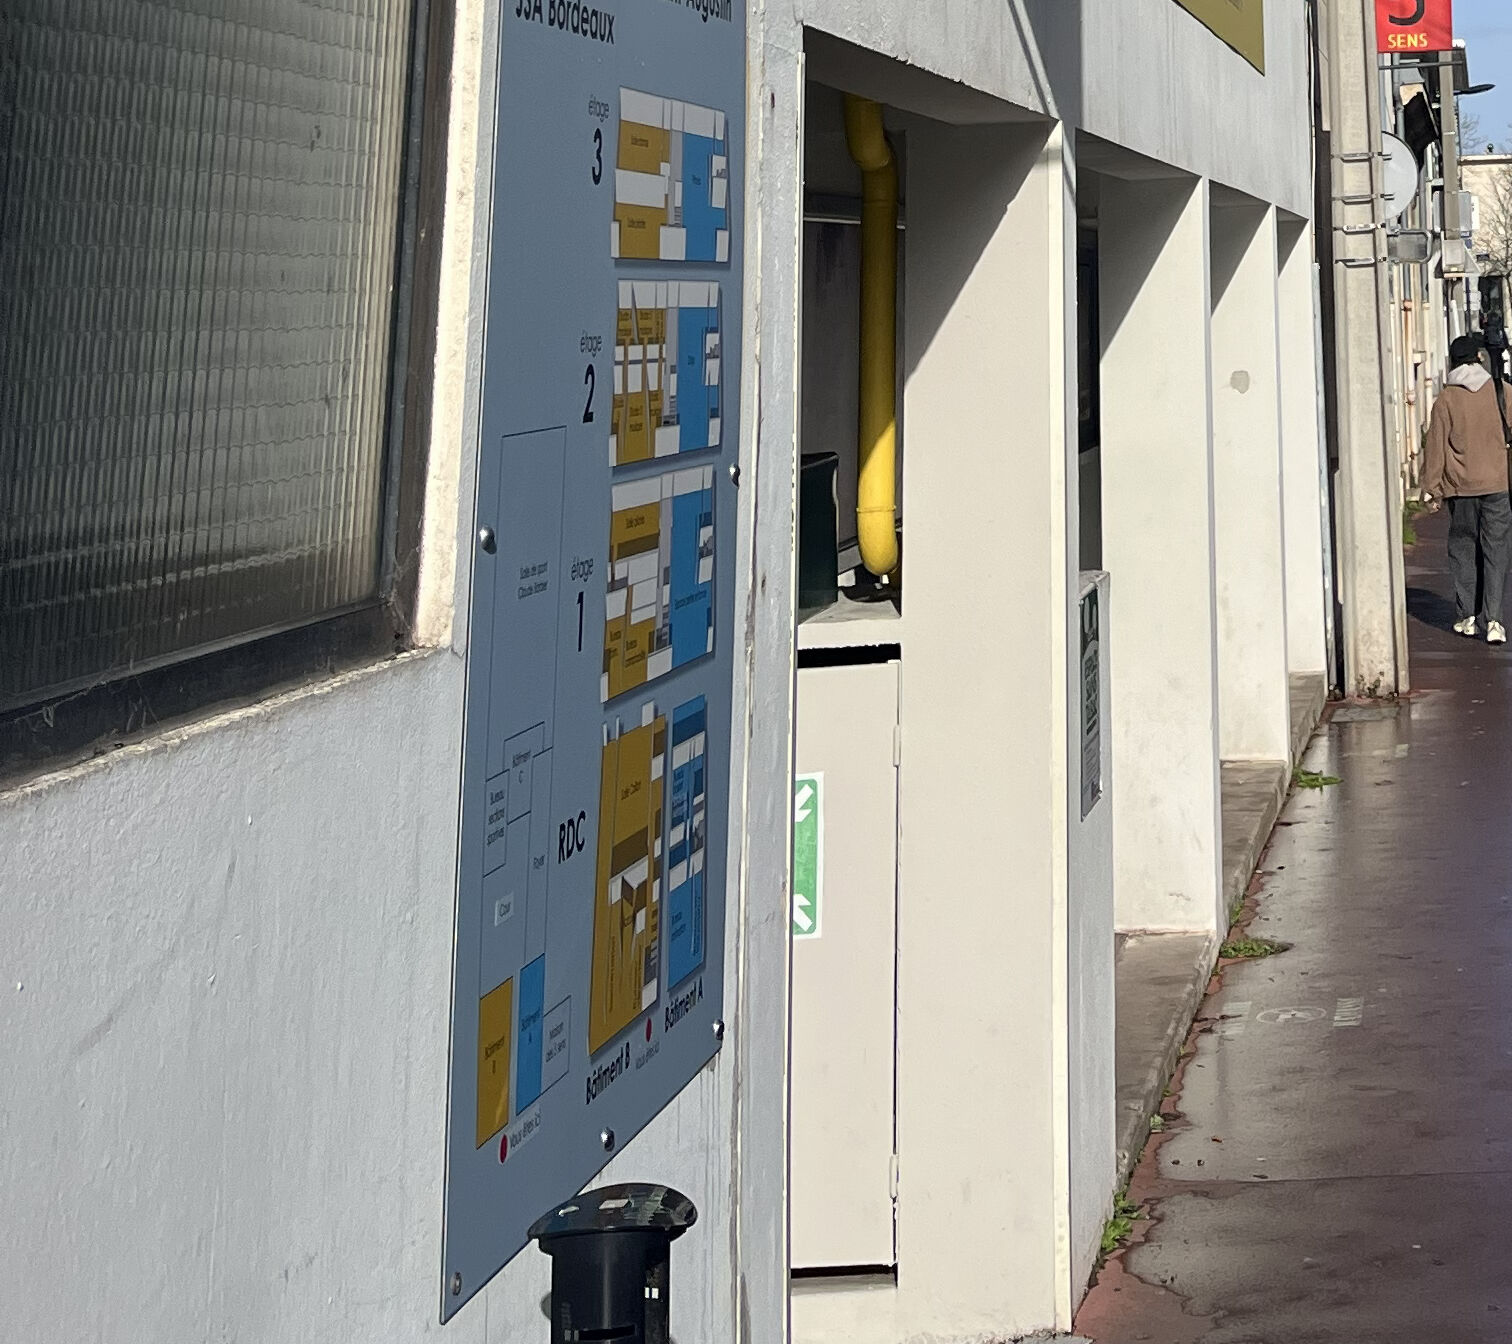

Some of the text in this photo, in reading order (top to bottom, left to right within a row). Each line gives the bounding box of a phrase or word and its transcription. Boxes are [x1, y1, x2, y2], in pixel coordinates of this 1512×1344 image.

[1387, 33, 1428, 49] SENS
[588, 94, 610, 124] étage
[591, 127, 603, 186] 3
[580, 329, 602, 358] étage
[582, 363, 596, 424] 2
[571, 556, 594, 582] étage
[576, 591, 584, 653] 1
[558, 810, 587, 865] RDC
[697, 975, 704, 1000] A
[585, 1041, 631, 1105] Bâtiment B
